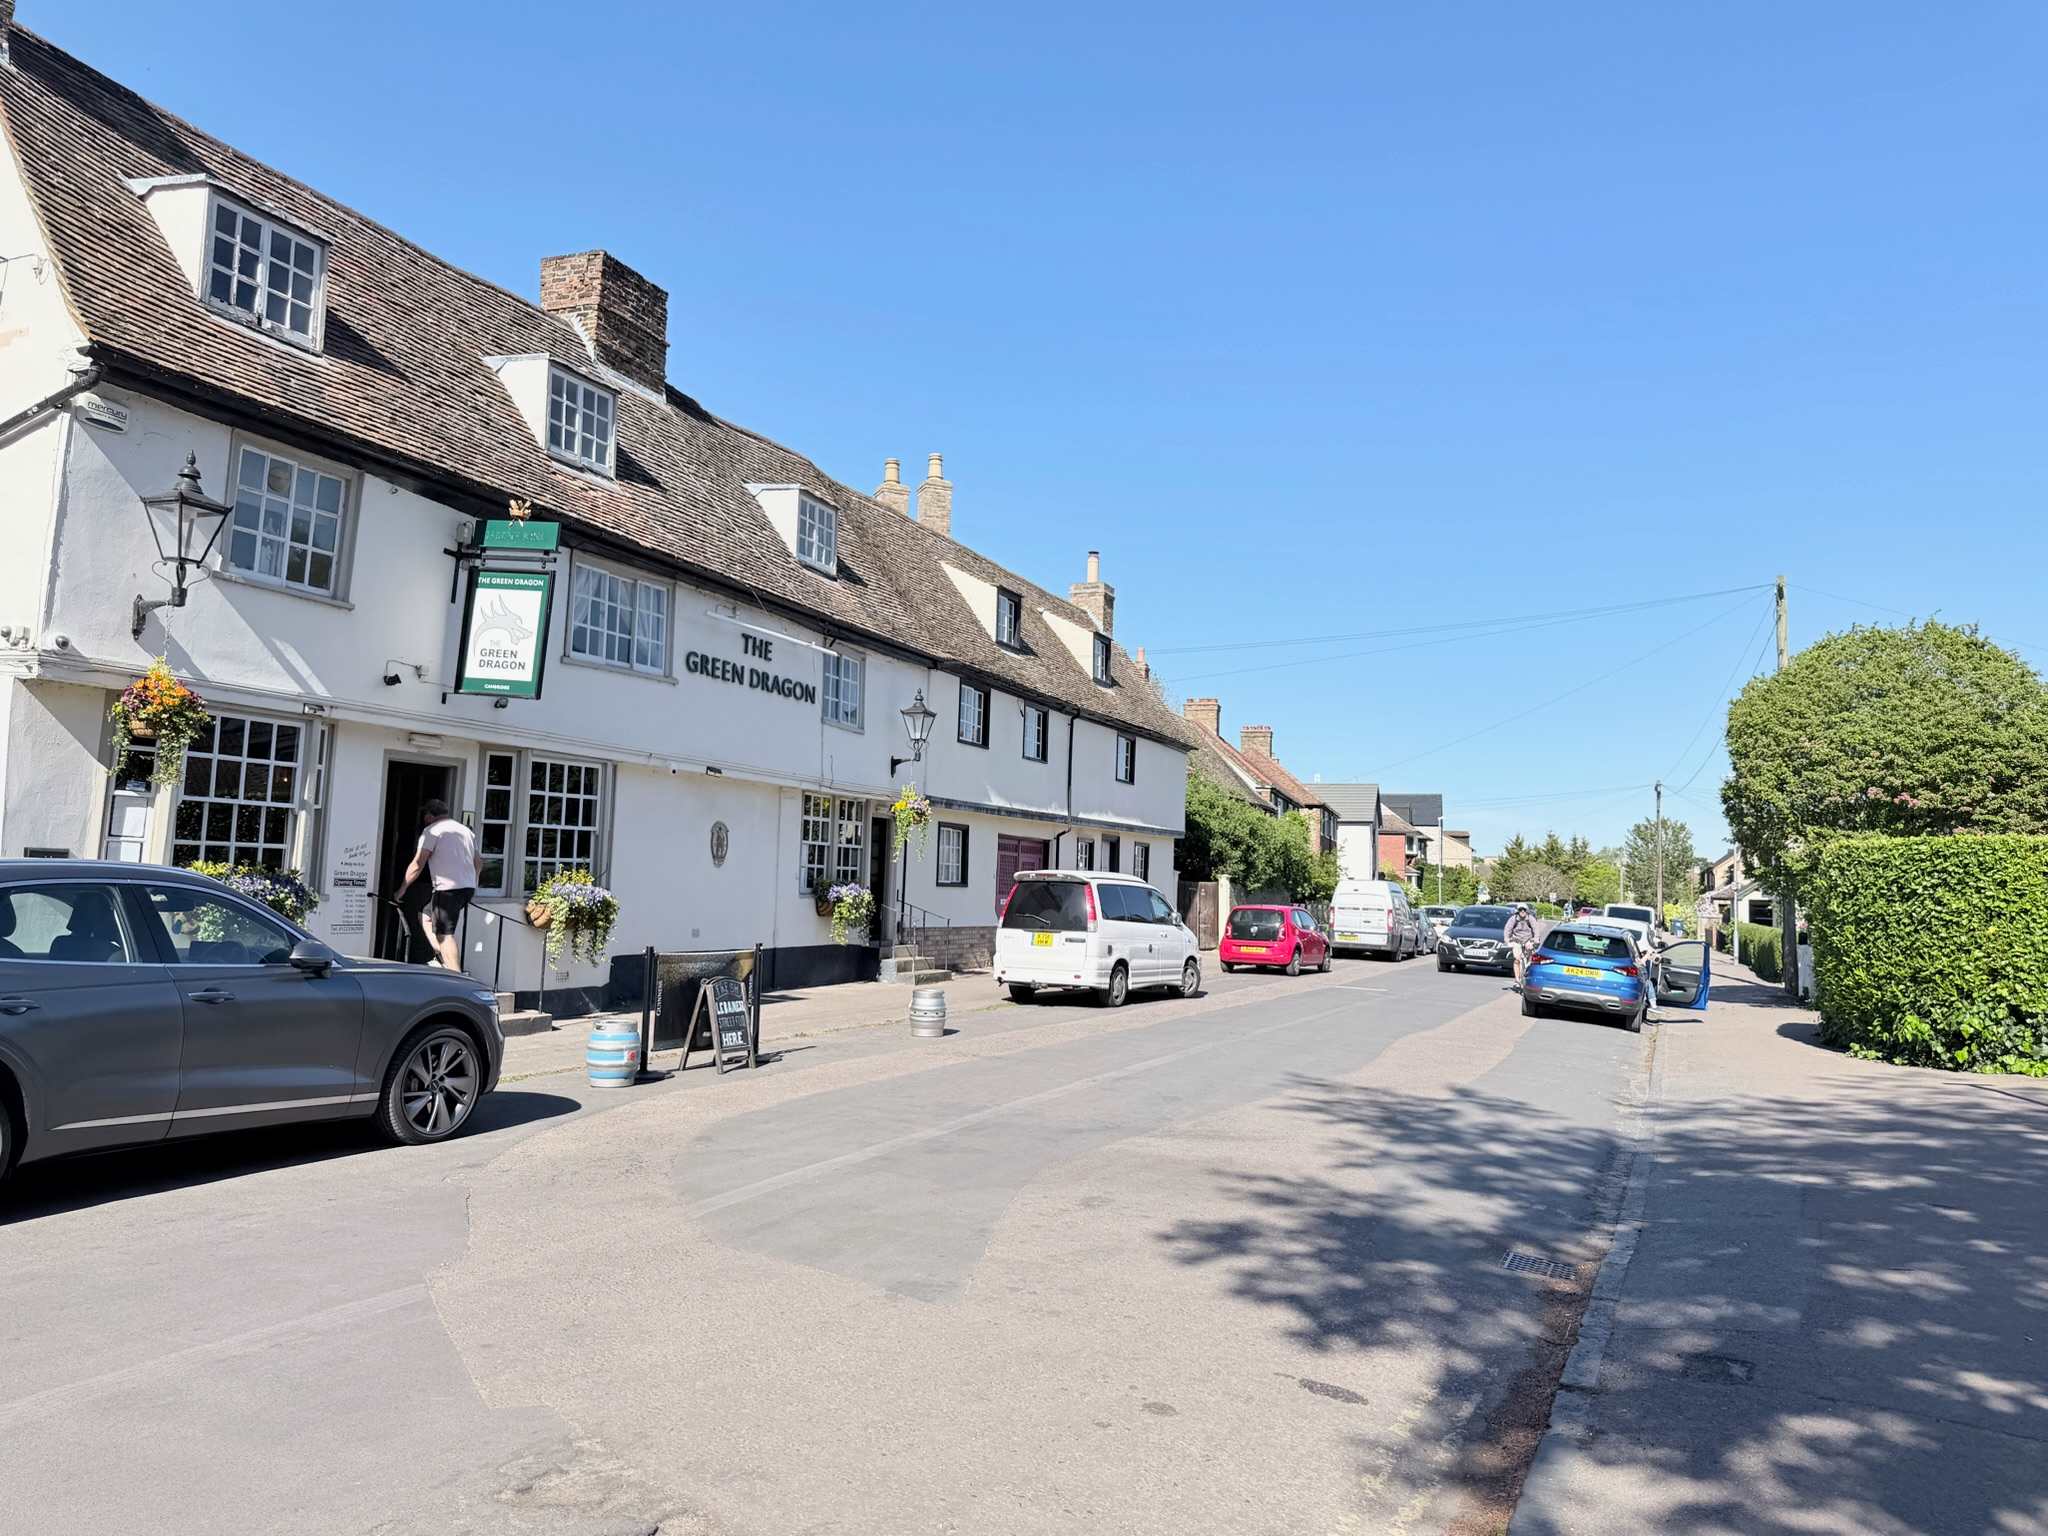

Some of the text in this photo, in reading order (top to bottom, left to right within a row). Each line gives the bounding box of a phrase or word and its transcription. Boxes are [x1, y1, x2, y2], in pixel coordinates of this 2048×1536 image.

[88, 401, 127, 420] mercury
[478, 576, 545, 588] THE GREEN DRAGON
[480, 648, 518, 659] GREEN
[741, 632, 774, 662] THE
[478, 659, 526, 670] DRAGON
[685, 651, 817, 704] GREEN DRAGON
[722, 1031, 744, 1047] HERE
